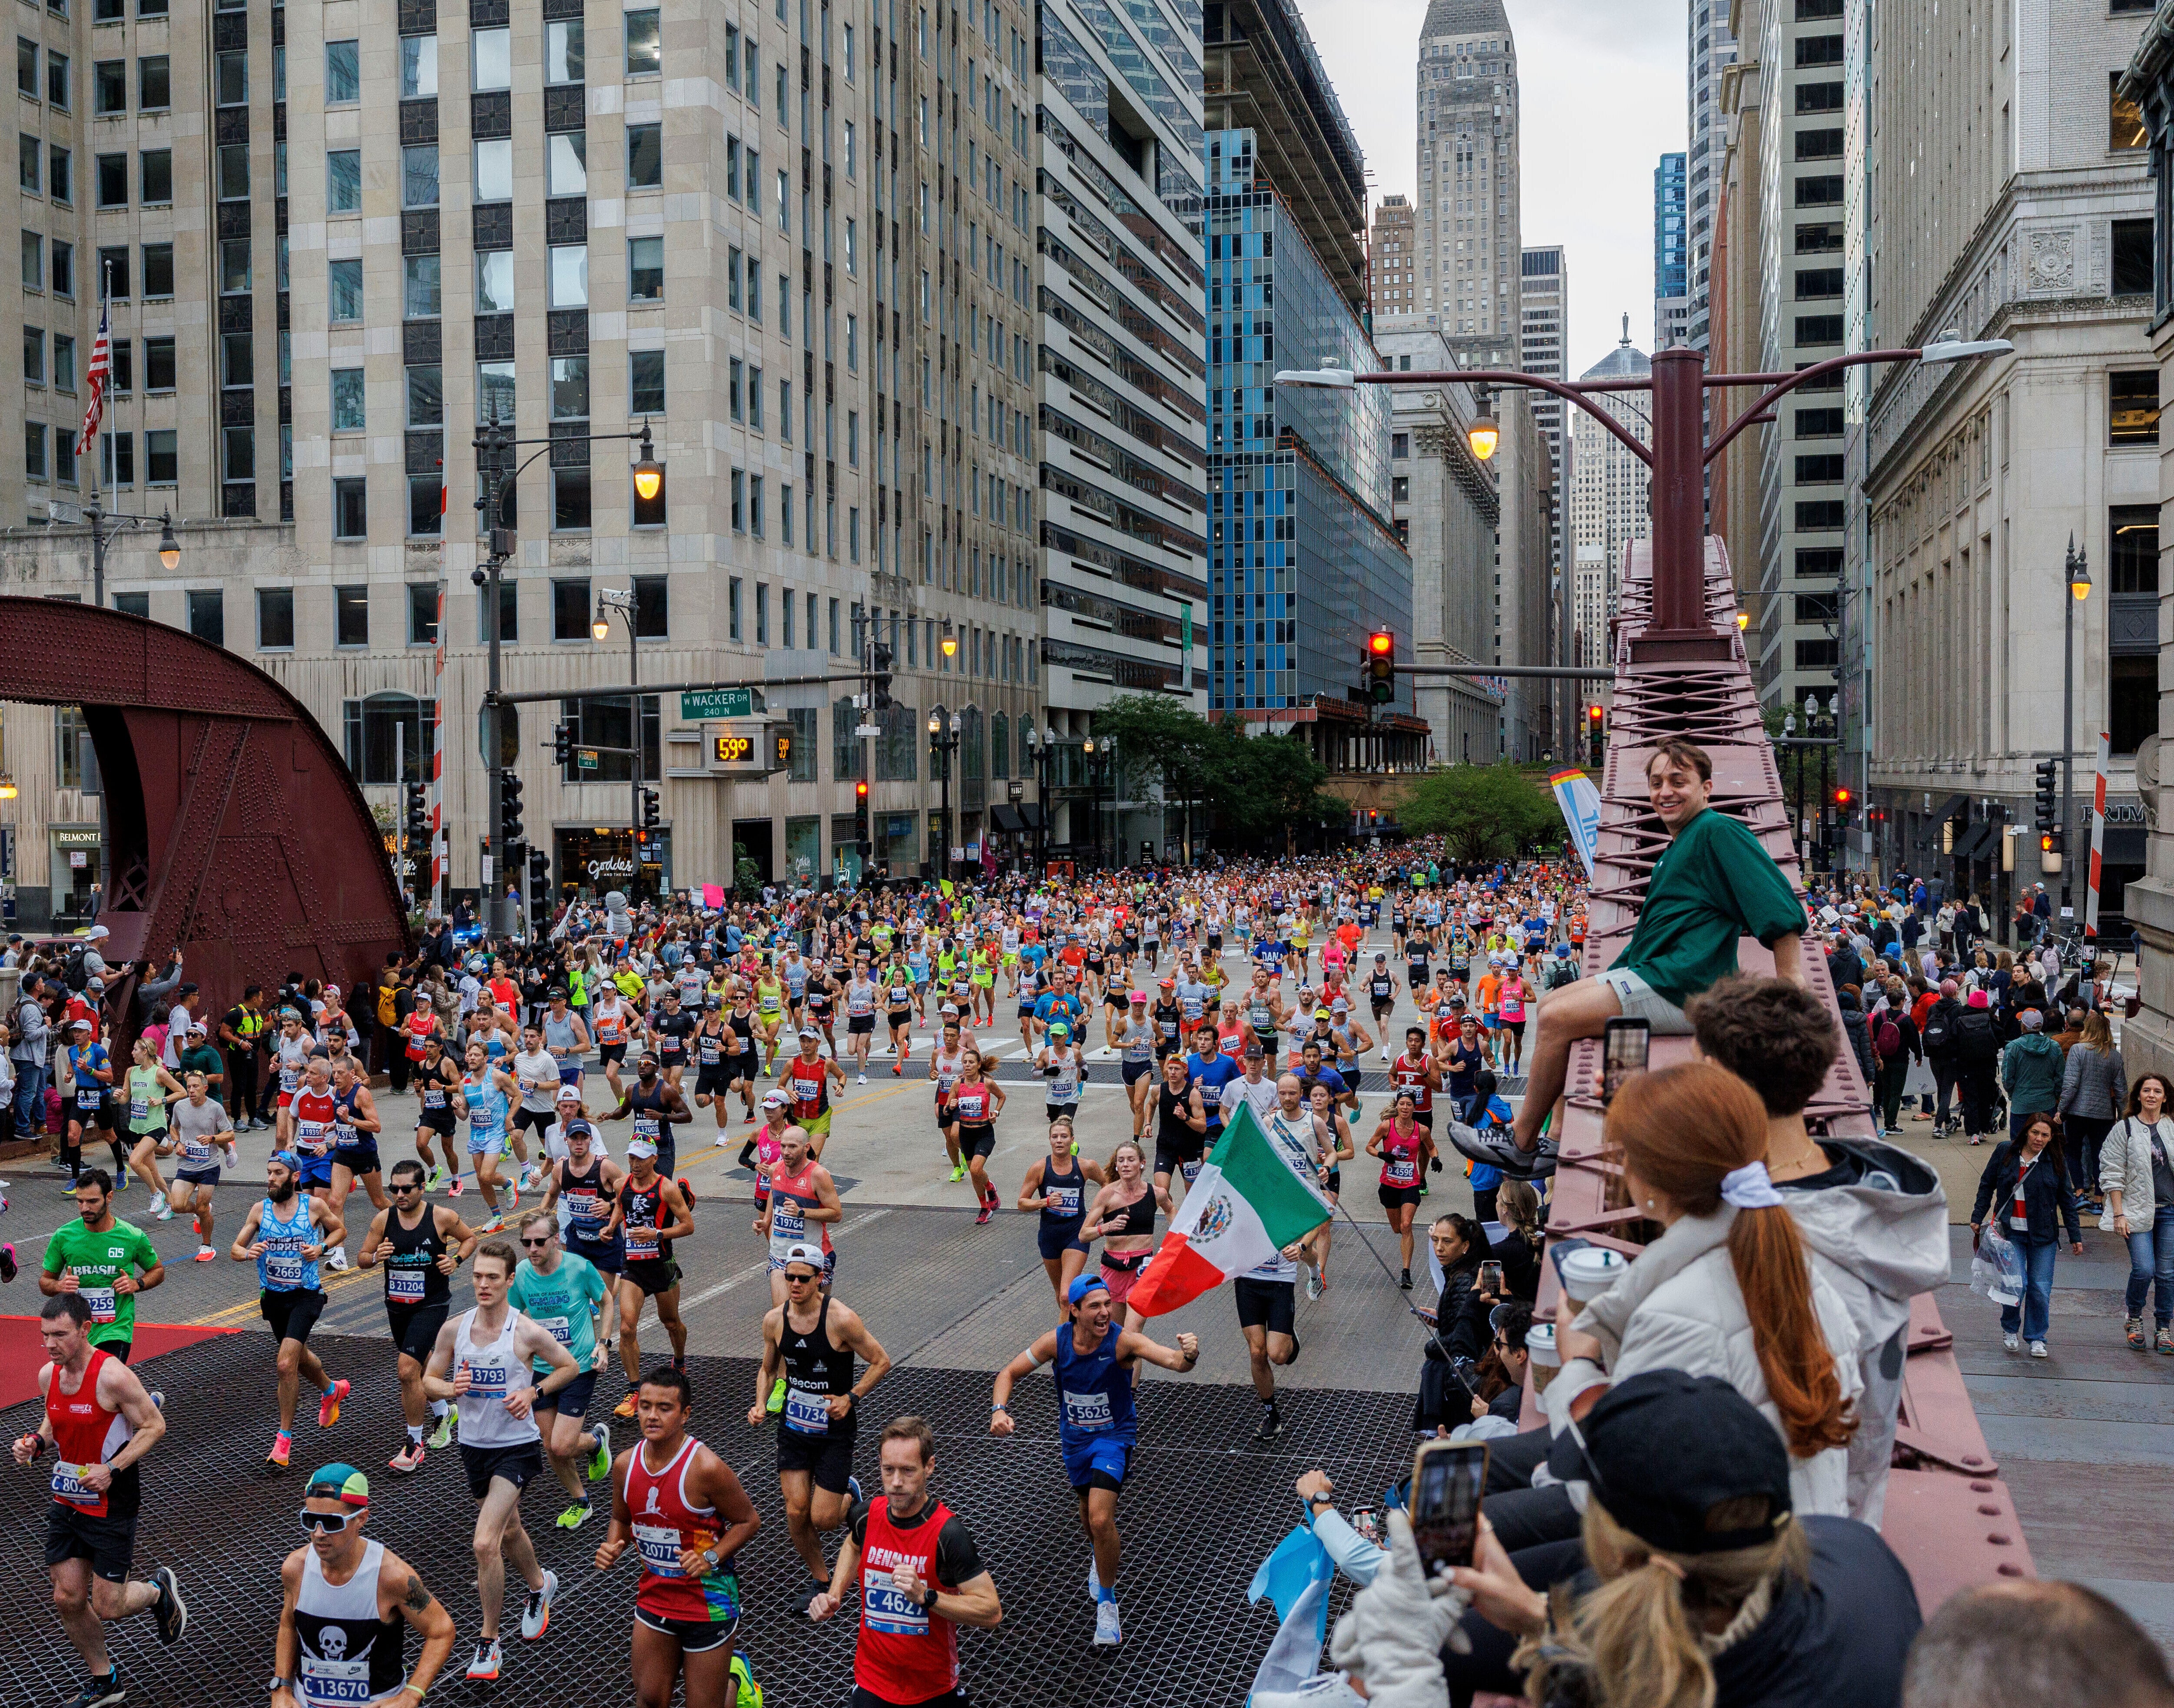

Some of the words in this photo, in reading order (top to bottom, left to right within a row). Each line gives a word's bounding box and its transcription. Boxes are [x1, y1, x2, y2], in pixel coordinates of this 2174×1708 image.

[693, 693, 736, 706] WACKER
[719, 738, 748, 759] 59°
[60, 832, 96, 841] BELMONT
[1405, 1075, 1415, 1085] P
[133, 1104, 147, 1113] 20665
[189, 1147, 209, 1155] 16638
[1395, 1167, 1413, 1177] 4596
[569, 1201, 573, 1211] C
[775, 1217, 779, 1225] C
[780, 1217, 803, 1229] 19764
[626, 1239, 631, 1247] B
[108, 1247, 124, 1258] 615
[73, 1265, 118, 1276] BRASIL
[267, 1266, 272, 1275] C
[275, 1265, 301, 1277] 2669
[390, 1280, 395, 1289] B
[397, 1281, 424, 1292] 21204
[529, 1295, 570, 1305] CHICAGO
[471, 1369, 505, 1382] 13793
[789, 1375, 829, 1390] teecom
[787, 1403, 795, 1416] C
[1067, 1405, 1075, 1417] C
[1077, 1404, 1110, 1417] 5626
[51, 1475, 60, 1491] C
[636, 1539, 643, 1552] C
[866, 1589, 876, 1608] C
[304, 1678, 313, 1693] C
[318, 1680, 368, 1698] 13670
